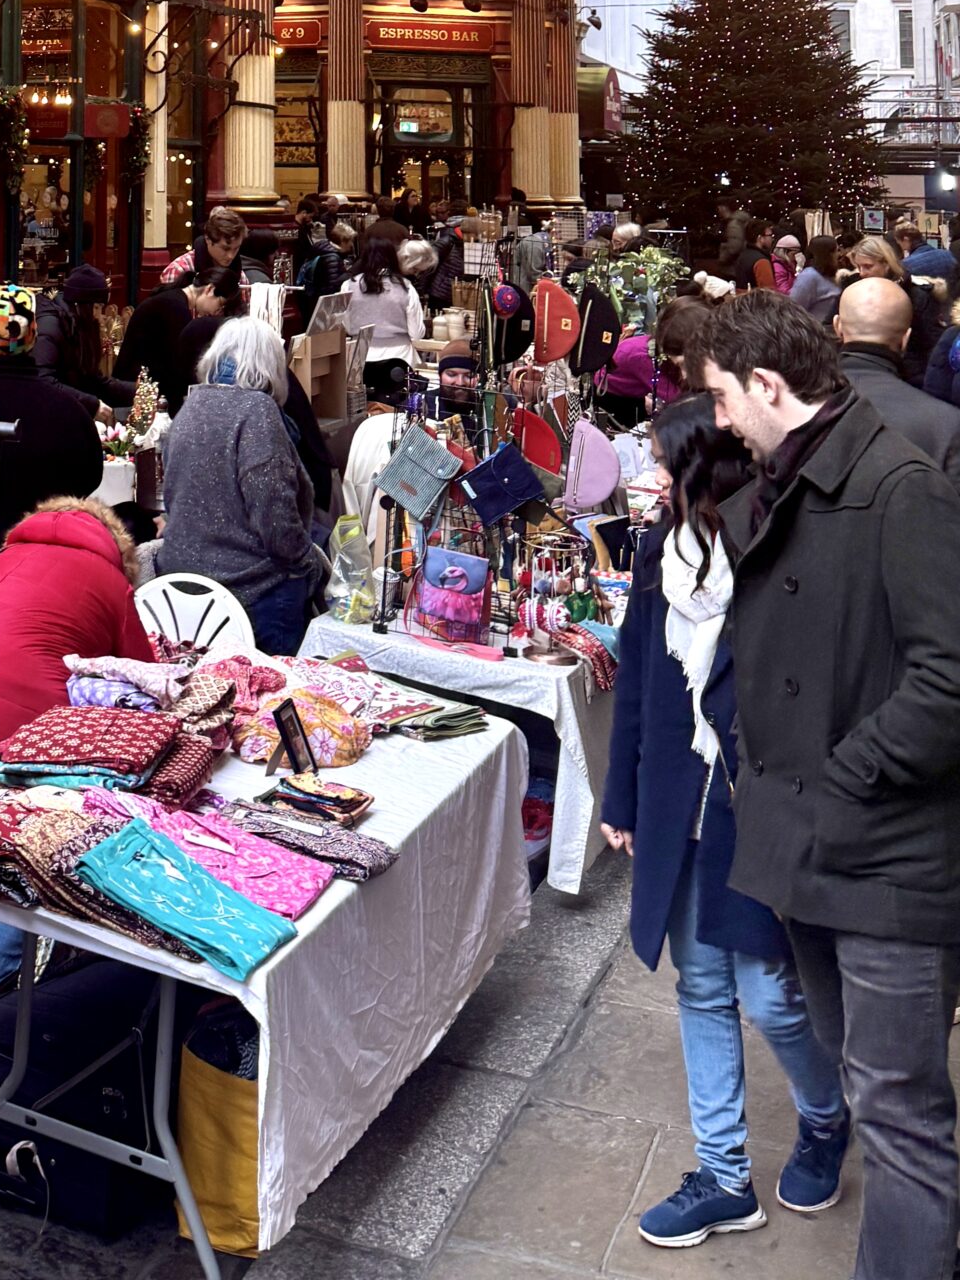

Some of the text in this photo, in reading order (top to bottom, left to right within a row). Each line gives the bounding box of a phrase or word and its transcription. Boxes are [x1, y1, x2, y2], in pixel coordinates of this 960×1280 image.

[296, 28, 305, 38] 9
[379, 27, 479, 42] ESPRESSO BAR
